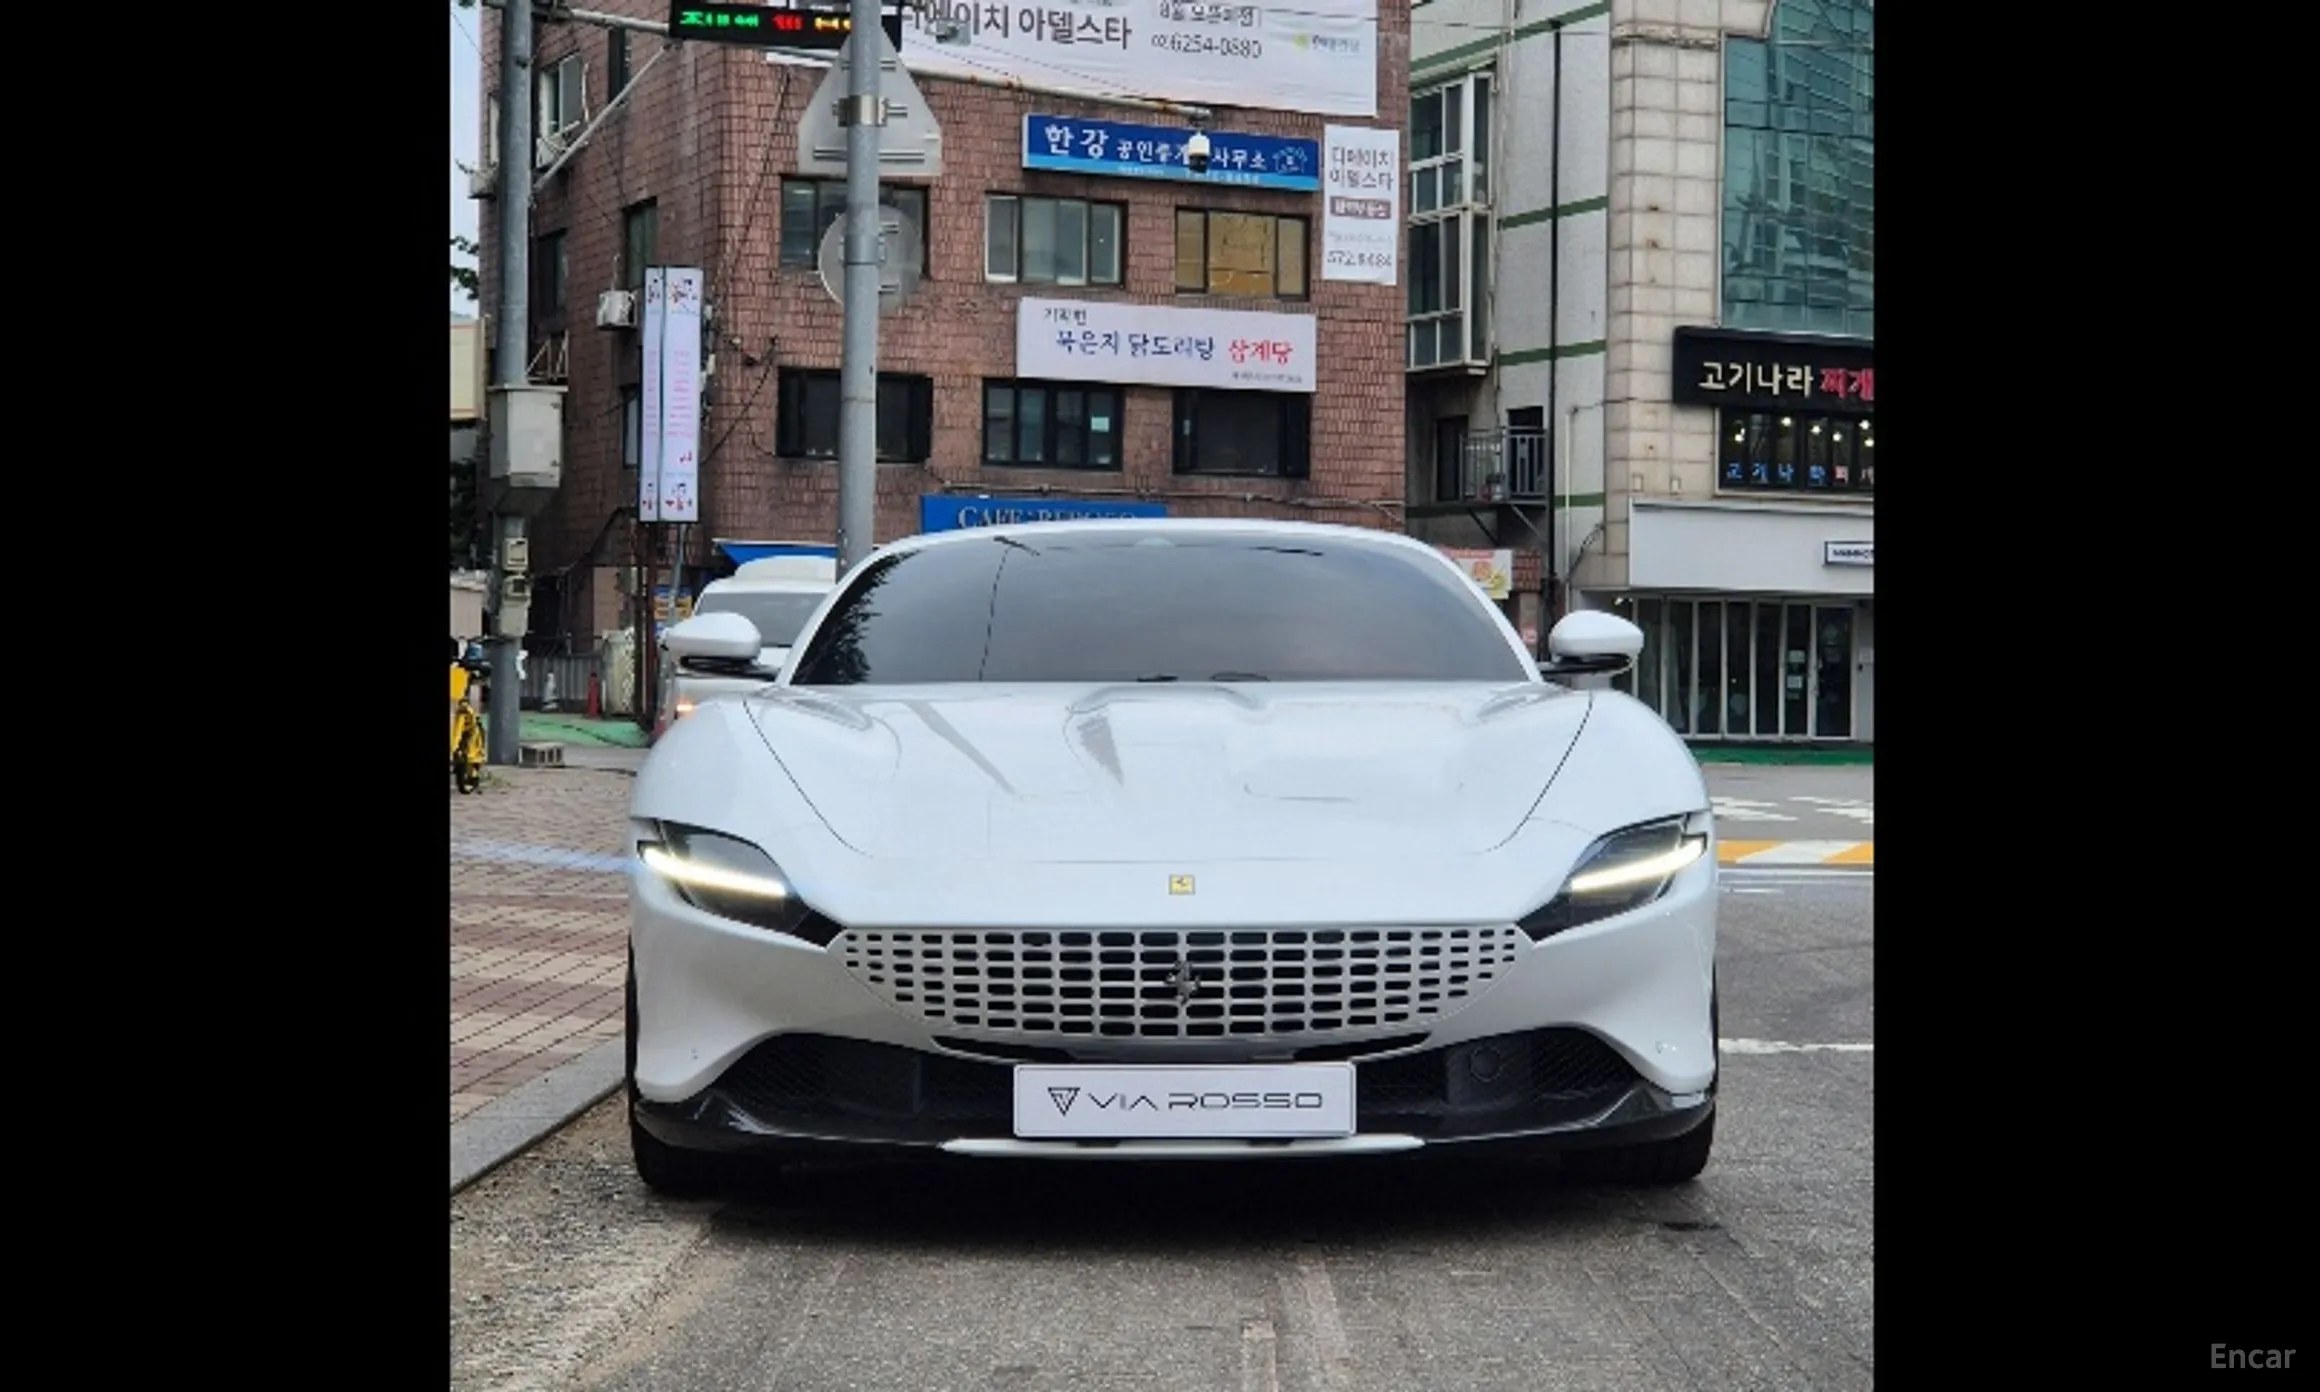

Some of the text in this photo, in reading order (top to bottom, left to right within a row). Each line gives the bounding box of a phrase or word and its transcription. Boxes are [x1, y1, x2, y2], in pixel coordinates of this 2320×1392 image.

[1019, 5, 1132, 50] 아델스타
[1044, 124, 1109, 159] 한강
[1699, 361, 1814, 399] 고기나라
[1088, 1092, 1323, 1111] VIA ROSSO
